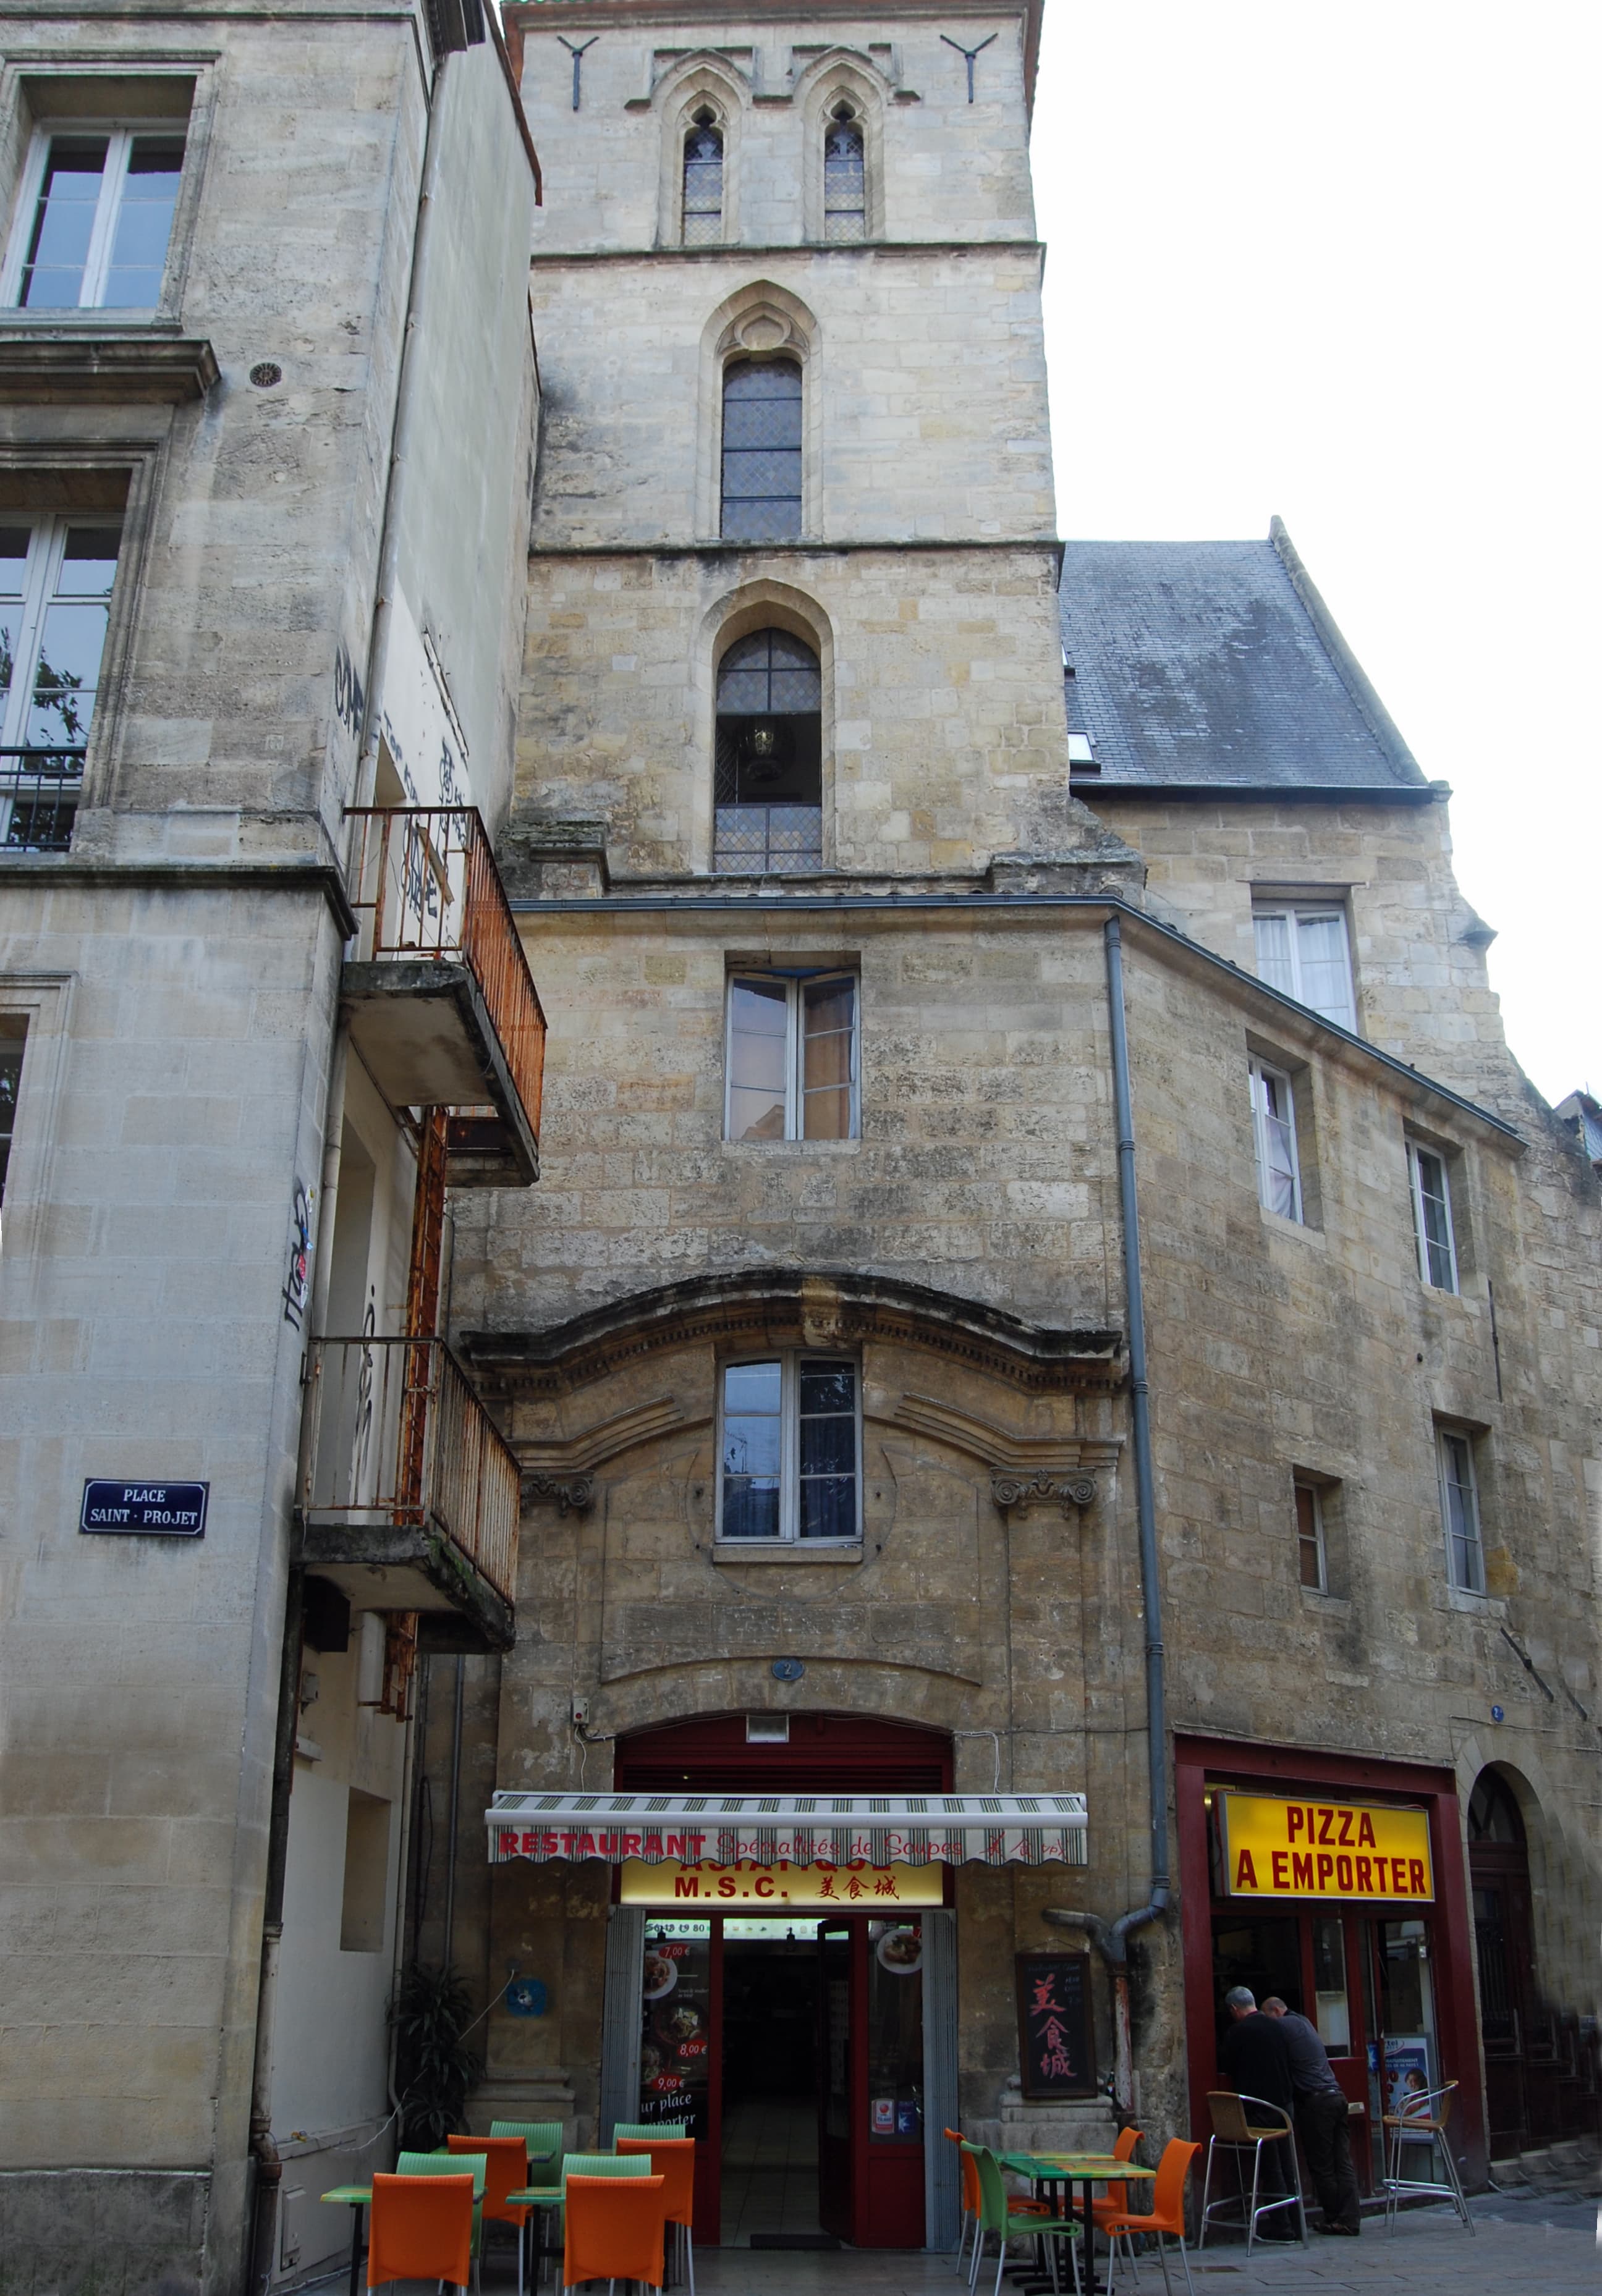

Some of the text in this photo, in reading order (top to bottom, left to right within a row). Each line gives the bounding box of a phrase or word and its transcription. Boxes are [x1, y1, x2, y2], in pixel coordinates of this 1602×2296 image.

[123, 1489, 166, 1503] PLACE
[90, 1508, 197, 1526] SAINT PROJET
[784, 1662, 792, 1675] 2
[1287, 1806, 1376, 1849] PIZZA
[499, 1833, 706, 1856] RESTAURANT
[716, 1833, 839, 1860] Spécialités
[850, 1836, 873, 1855] de
[884, 1834, 963, 1860] Soupes
[1237, 1849, 1426, 1894] A EMPORTER
[675, 1875, 900, 1901] M.S.C. 美食城
[693, 1924, 705, 1932] 80
[665, 1947, 690, 1959] 7,00 €
[1030, 1973, 1077, 2079] 美食城
[680, 2043, 708, 2057] 8,00 €
[658, 2078, 687, 2091] 9,00 €
[659, 2093, 692, 2112] place
